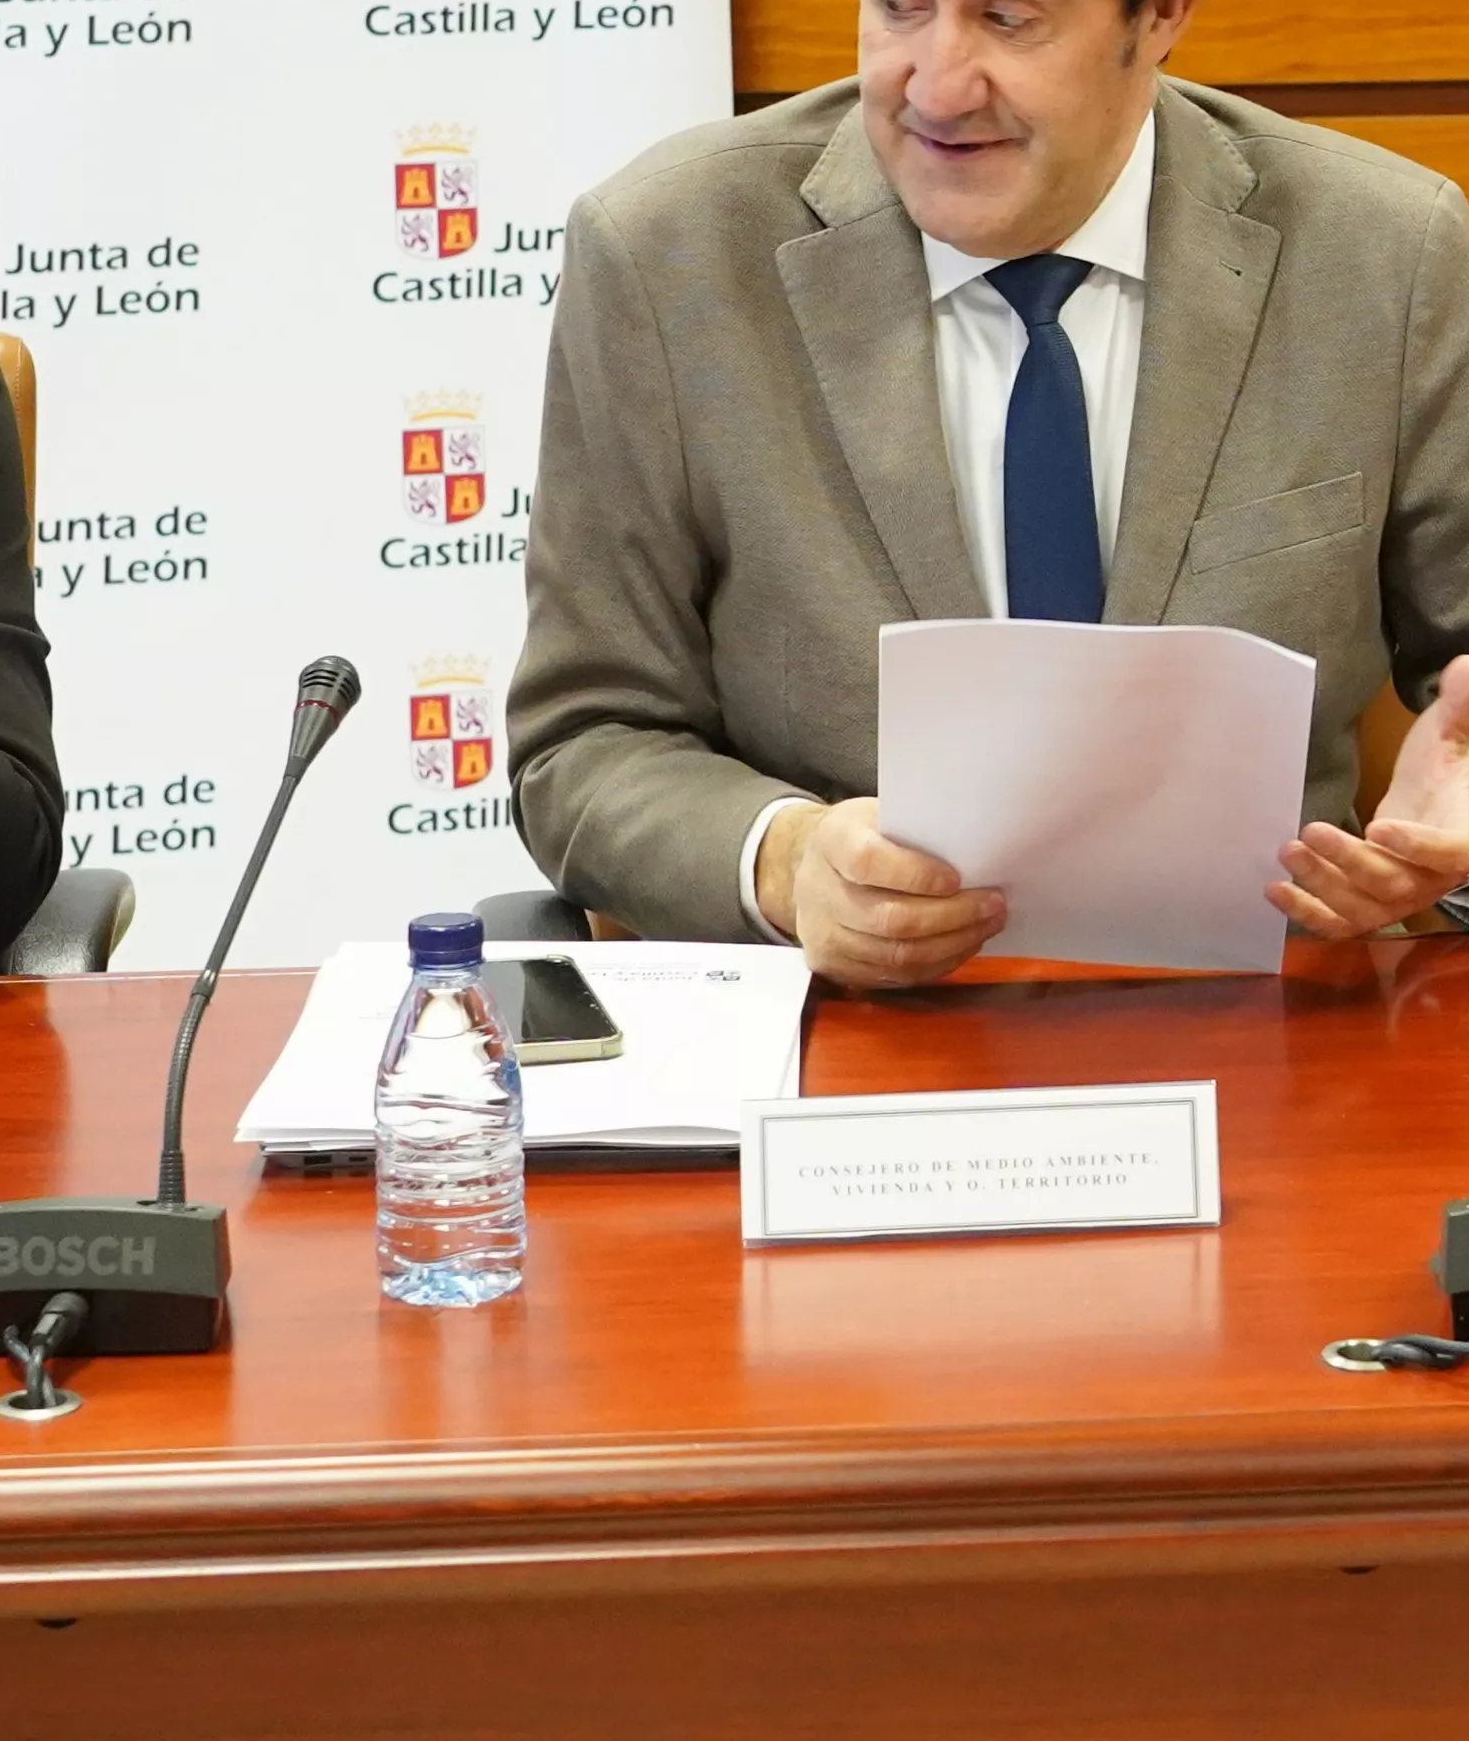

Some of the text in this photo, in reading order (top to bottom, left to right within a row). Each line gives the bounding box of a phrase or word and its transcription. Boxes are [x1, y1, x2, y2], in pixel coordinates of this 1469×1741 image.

[46, 25, 67, 56] y
[89, 16, 190, 44] León
[366, 1, 672, 40] Castilla y León
[7, 238, 198, 274] Junta de
[496, 224, 564, 252] Jun
[374, 269, 561, 306] Castilla y
[54, 296, 75, 327] y
[97, 287, 198, 314] León
[39, 507, 206, 542] unta de
[63, 565, 83, 597] y
[105, 556, 206, 584] León
[64, 776, 214, 811] nta de
[389, 799, 510, 833] Castill
[71, 826, 214, 867] y León
[798, 1161, 921, 1178] CONSEJERO
[931, 1160, 955, 1173] DE
[967, 1157, 1035, 1171] MEDIO
[832, 1181, 935, 1197] VIVIENDA
[943, 1180, 957, 1193] Y
[998, 1173, 1128, 1190] TERRITORIO
